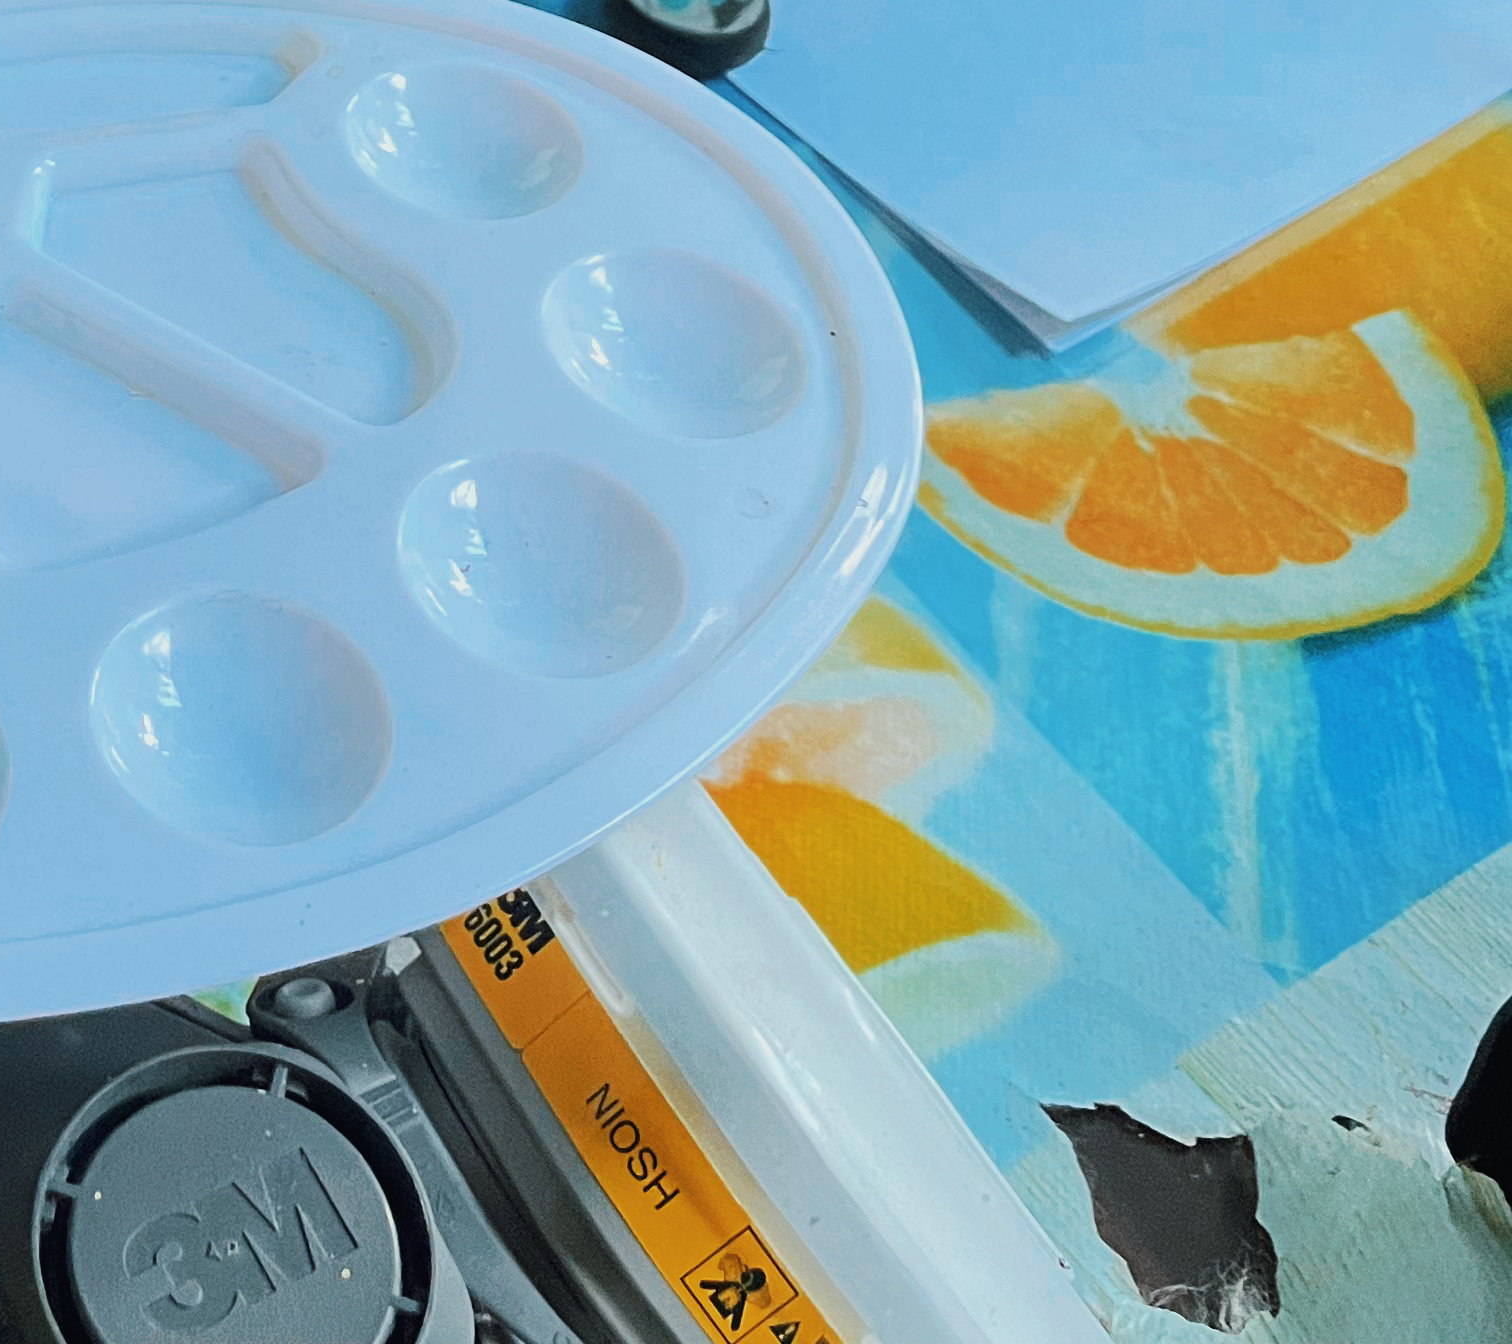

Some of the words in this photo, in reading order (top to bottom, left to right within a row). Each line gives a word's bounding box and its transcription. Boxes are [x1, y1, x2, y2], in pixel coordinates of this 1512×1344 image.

[463, 902, 525, 982] 6003
[585, 1082, 680, 1211] NIOSH
[122, 1144, 360, 1334] 3M
